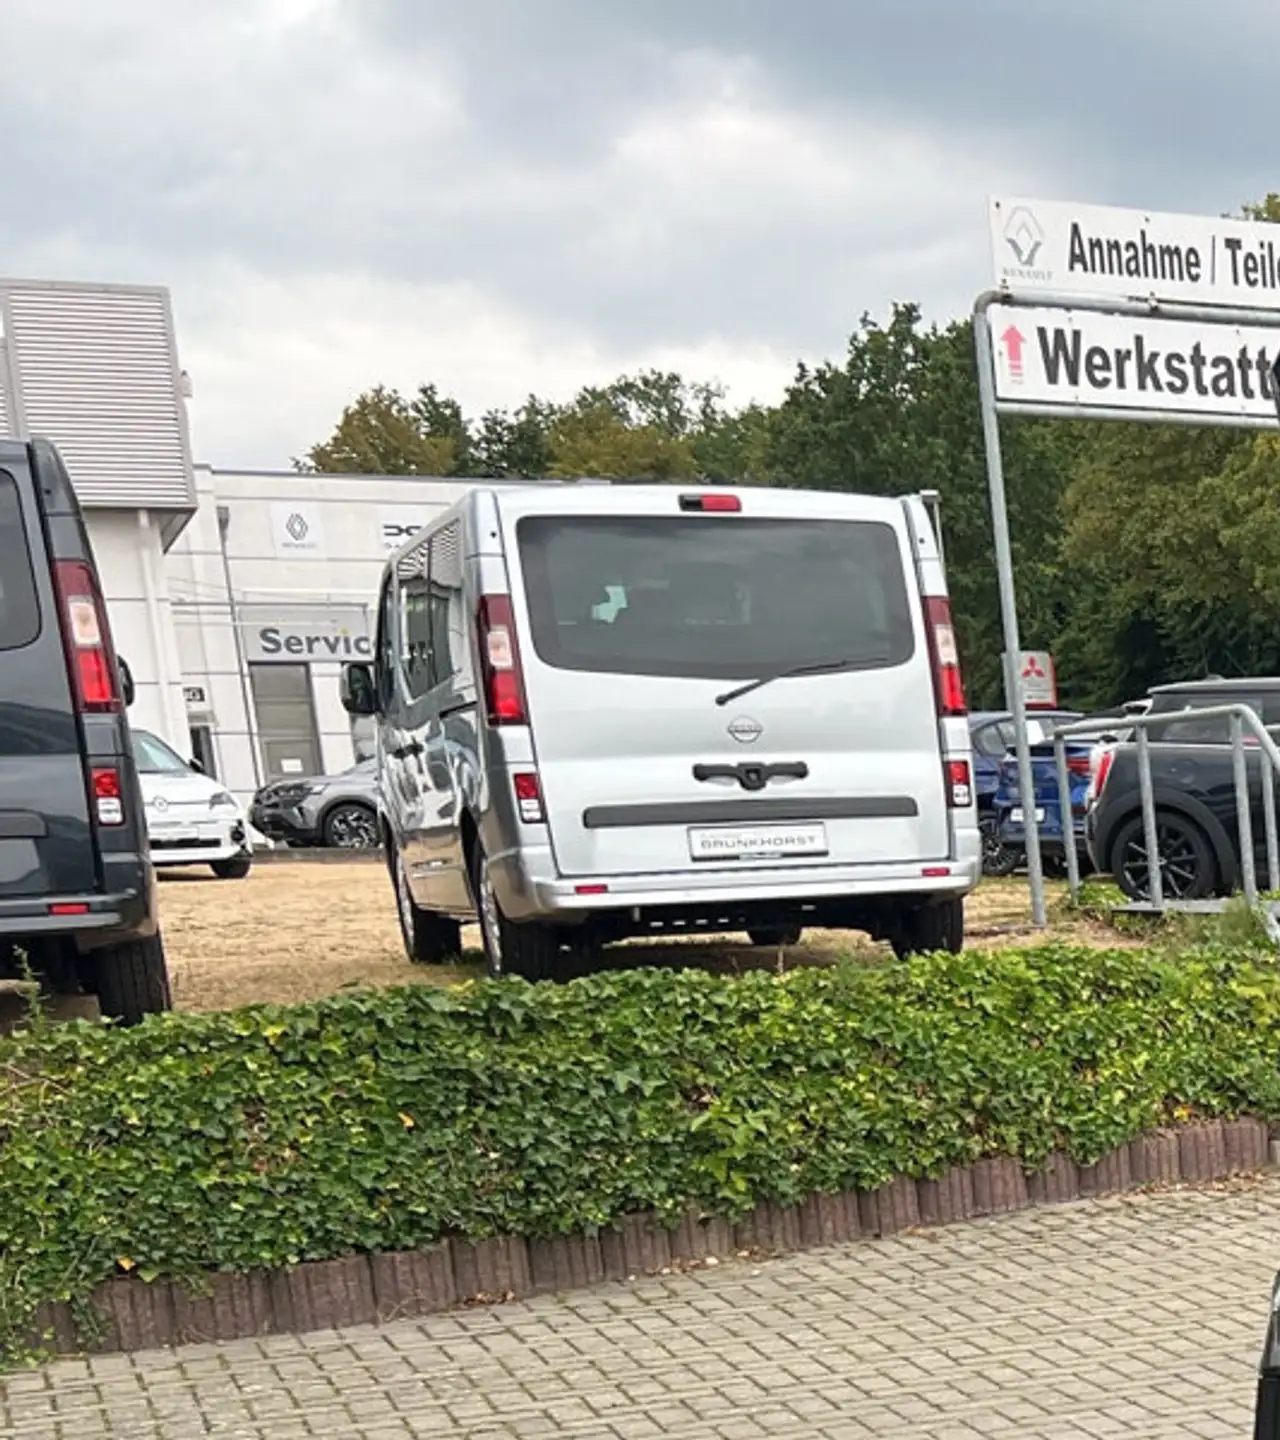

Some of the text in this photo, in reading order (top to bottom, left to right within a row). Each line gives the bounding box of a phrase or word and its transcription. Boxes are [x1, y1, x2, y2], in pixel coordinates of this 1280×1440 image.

[1068, 221, 1201, 283] Annahme
[1037, 326, 1276, 399] Werkstatt
[259, 627, 374, 654] Servic
